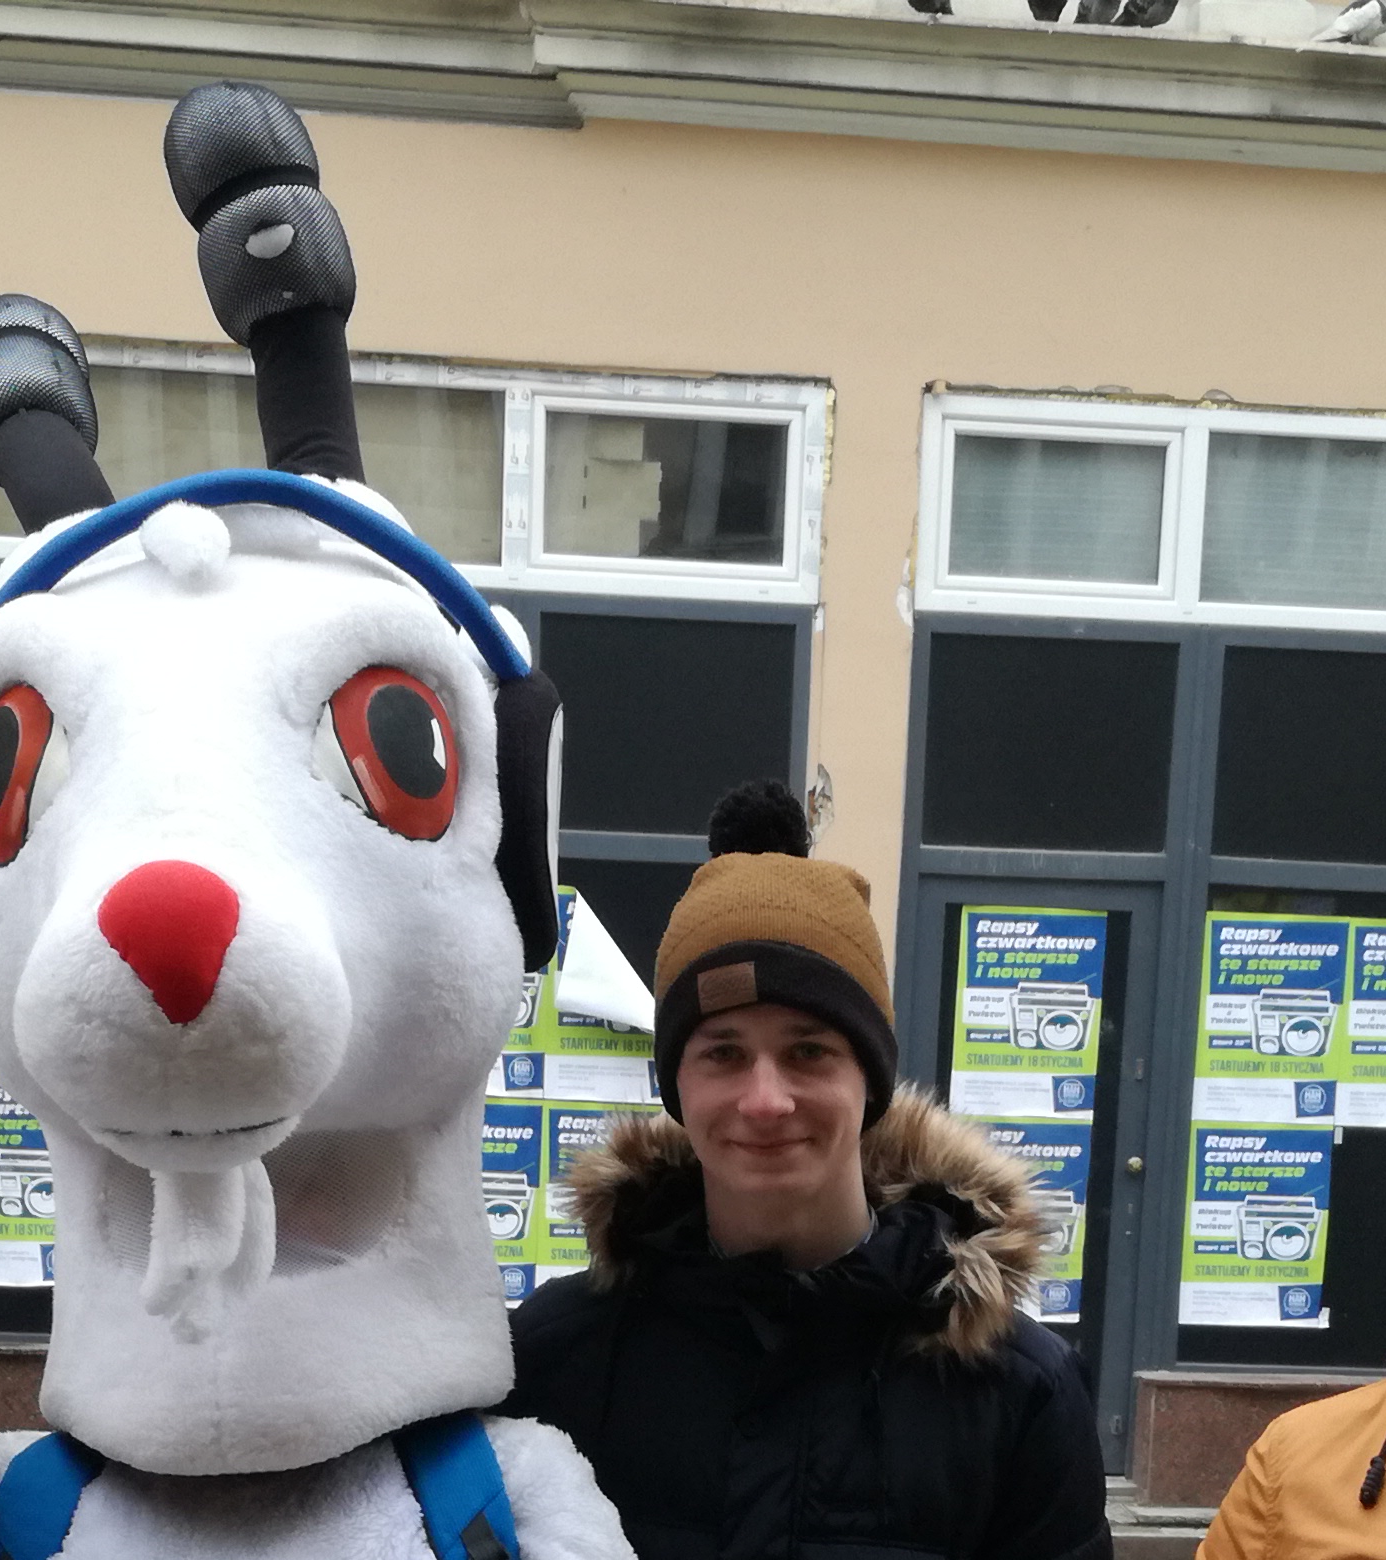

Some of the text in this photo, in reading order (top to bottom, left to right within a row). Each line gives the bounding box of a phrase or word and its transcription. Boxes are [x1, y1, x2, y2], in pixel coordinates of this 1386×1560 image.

[976, 920, 1039, 935] Rapsy
[1220, 927, 1282, 942] Rapsy
[975, 935, 1096, 949] czwartkowe
[1219, 942, 1338, 956] czwartkowe
[976, 951, 1078, 964] te starsze
[1219, 957, 1320, 970] te starsze
[974, 965, 1041, 978] i nowe
[1362, 964, 1384, 976] te
[1218, 971, 1284, 985] i nowe
[1361, 978, 1368, 990] i
[559, 1037, 619, 1051] STARTUJEMY
[622, 1039, 633, 1052] 18
[966, 1054, 1083, 1067] STARTUJEMY 18 STYCZNIA
[1209, 1060, 1323, 1073] STARTUJEMY 18 STYCZNIA
[1204, 1135, 1267, 1150] Rapsy
[1203, 1149, 1323, 1163] czwartkowe
[1204, 1165, 1305, 1177] te starsze
[1203, 1179, 1268, 1191] i nowe
[14, 1223, 26, 1236] 18
[1195, 1264, 1309, 1277] STARTUJEMY 18 STYCZNIA
